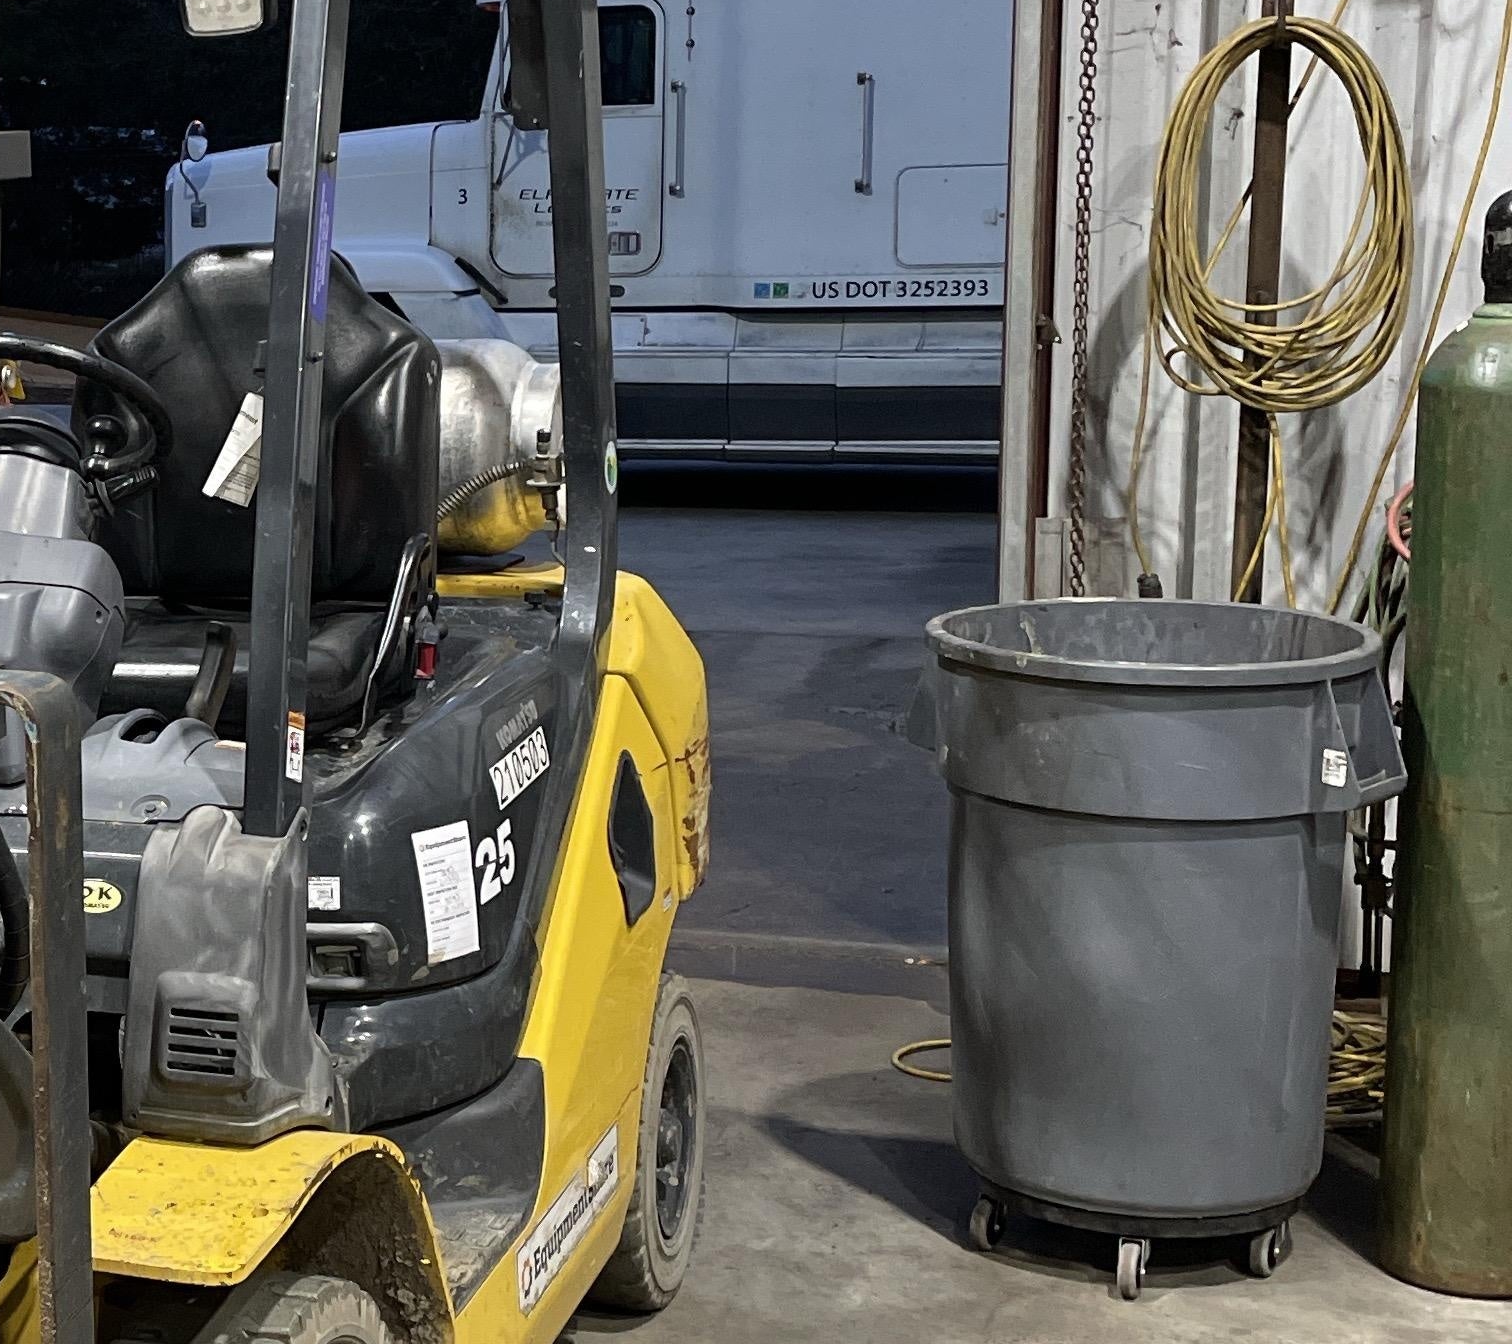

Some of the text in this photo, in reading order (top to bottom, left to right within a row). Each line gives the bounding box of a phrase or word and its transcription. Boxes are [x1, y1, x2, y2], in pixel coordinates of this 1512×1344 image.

[458, 188, 468, 205] 3
[812, 279, 989, 299] US DOT 3252393
[493, 730, 548, 806] 210503
[475, 818, 516, 906] 25
